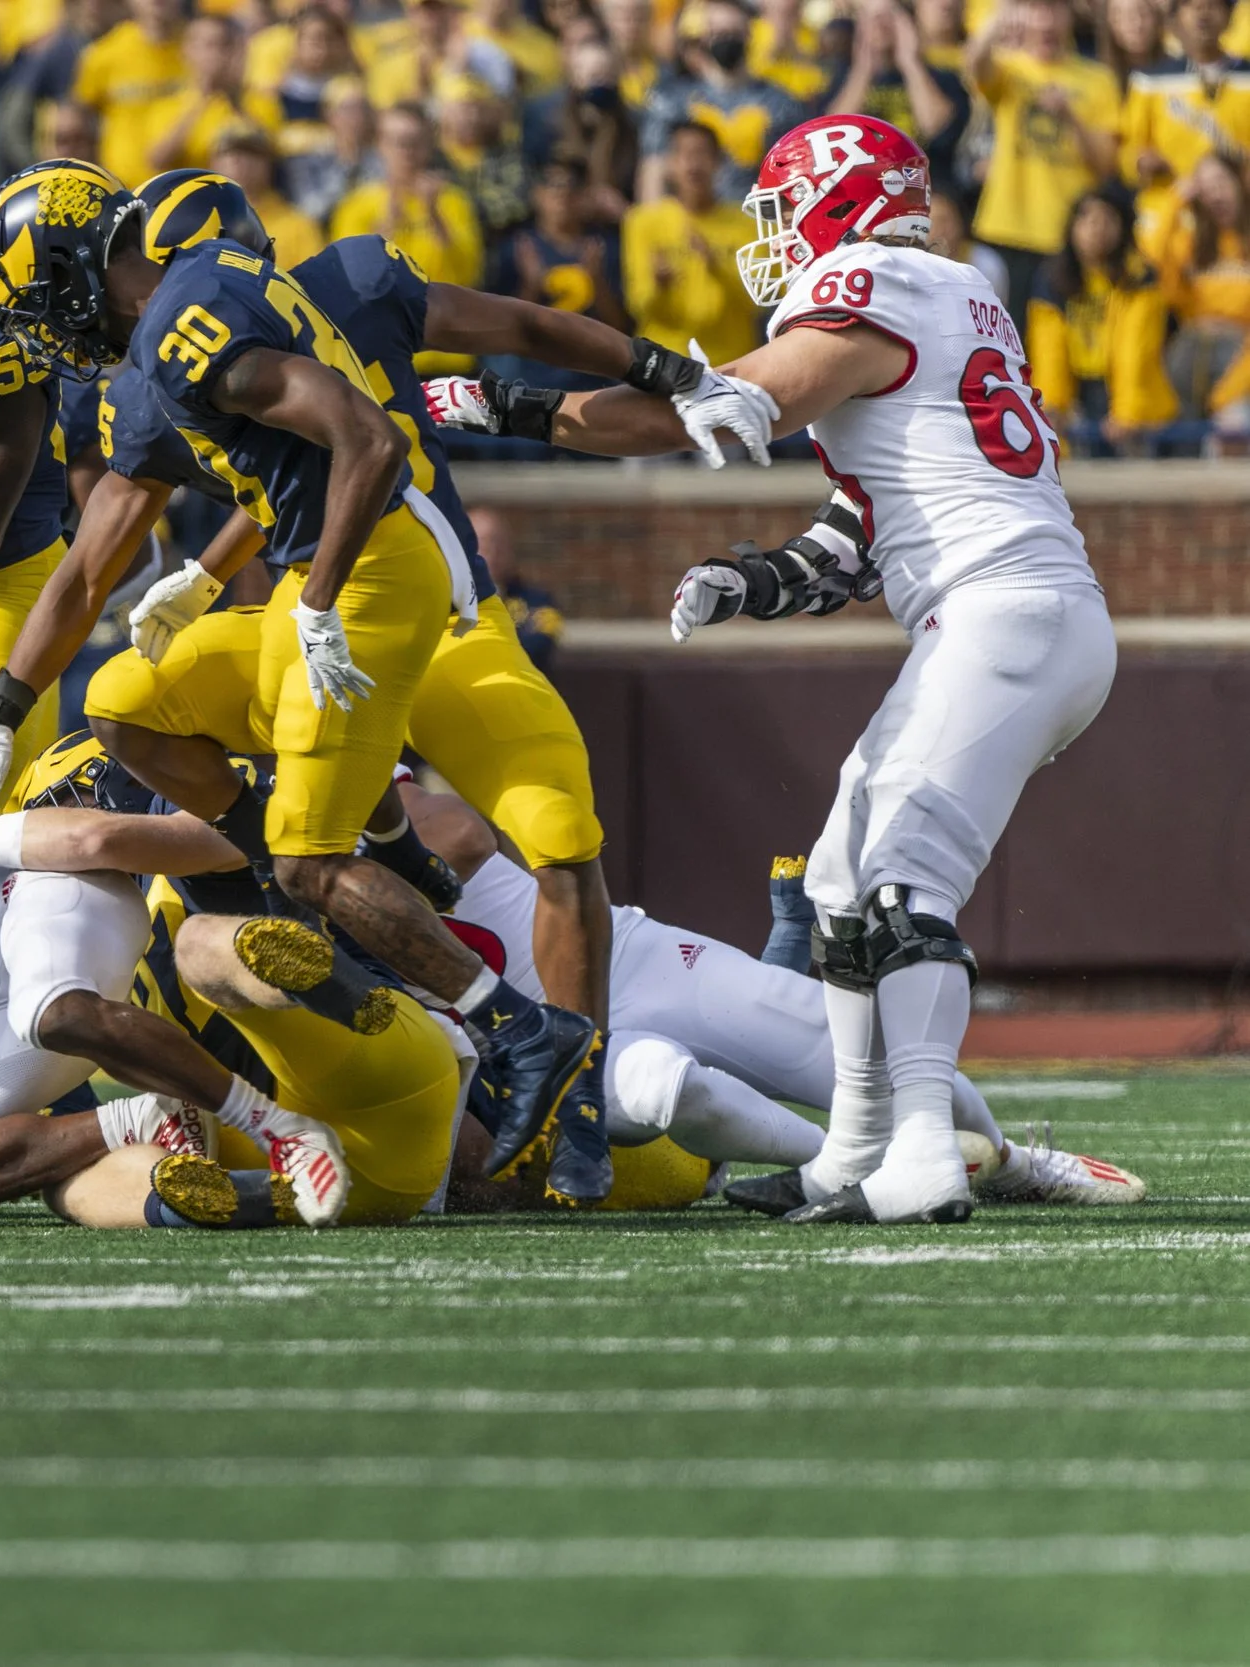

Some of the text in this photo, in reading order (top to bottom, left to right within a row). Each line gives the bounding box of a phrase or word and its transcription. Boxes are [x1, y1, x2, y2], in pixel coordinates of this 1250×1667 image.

[804, 125, 875, 176] R
[811, 268, 873, 308] 69
[158, 304, 231, 383] 30
[686, 944, 707, 970] adidas
